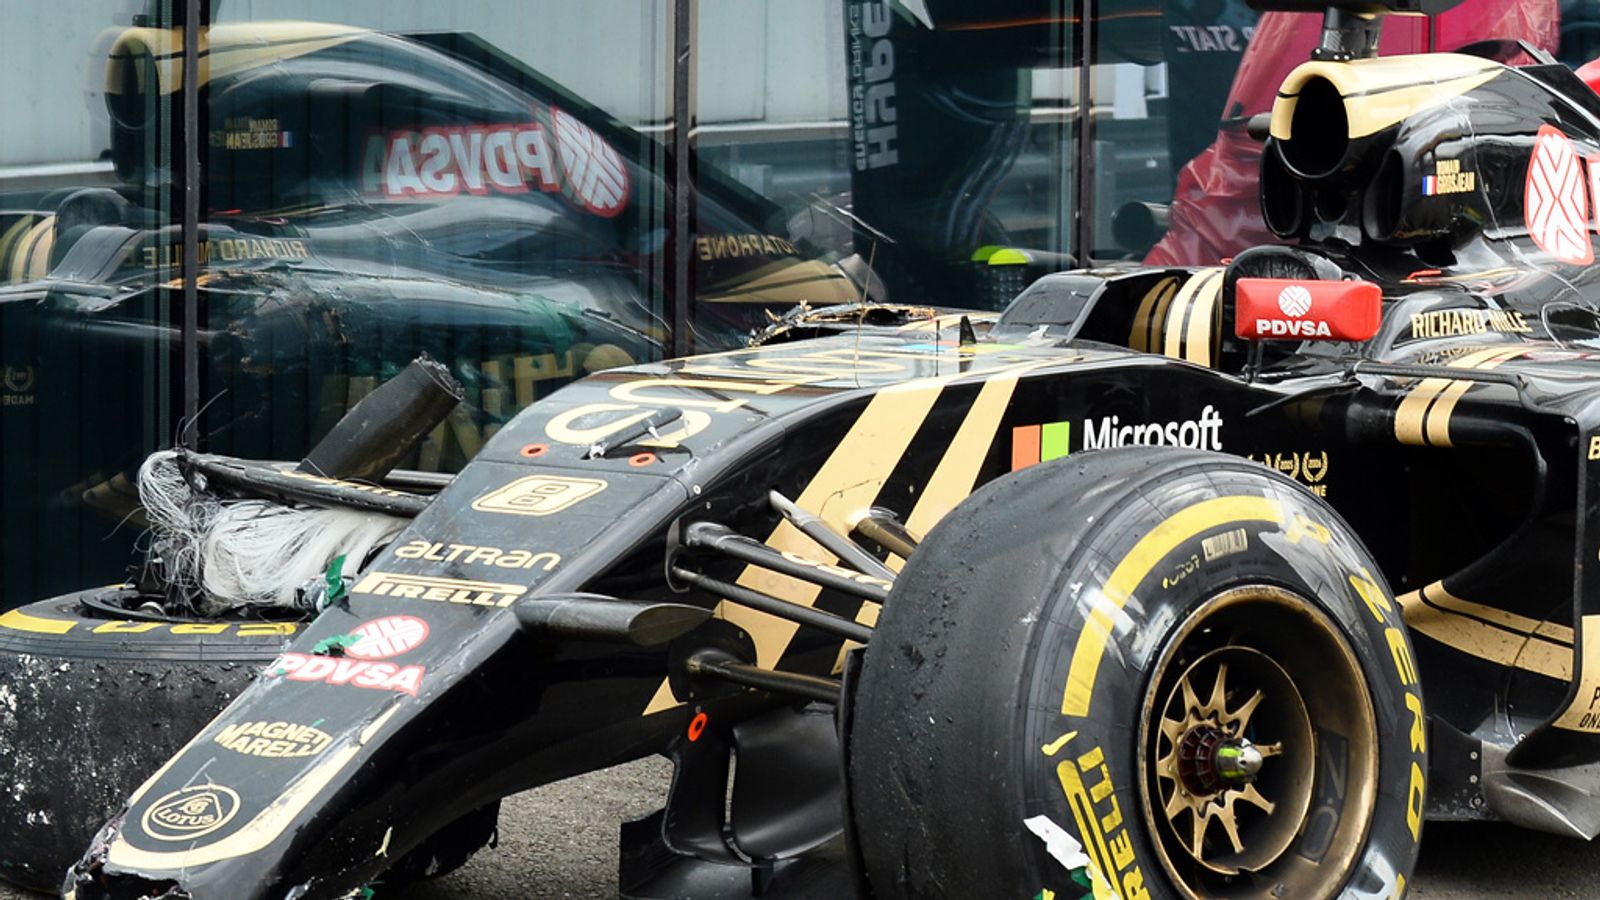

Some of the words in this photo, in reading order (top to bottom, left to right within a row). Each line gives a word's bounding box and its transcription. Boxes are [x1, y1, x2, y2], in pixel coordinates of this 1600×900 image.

[1255, 318, 1332, 337] PDVSA
[1409, 311, 1488, 339] RICHARD
[1487, 309, 1534, 334] MILLE
[1083, 404, 1223, 451] Microsoft
[352, 571, 528, 608] PIRELLI
[268, 653, 427, 696] PDVSA
[157, 808, 215, 826] LOTUS
[1057, 745, 1152, 900] RELLI
